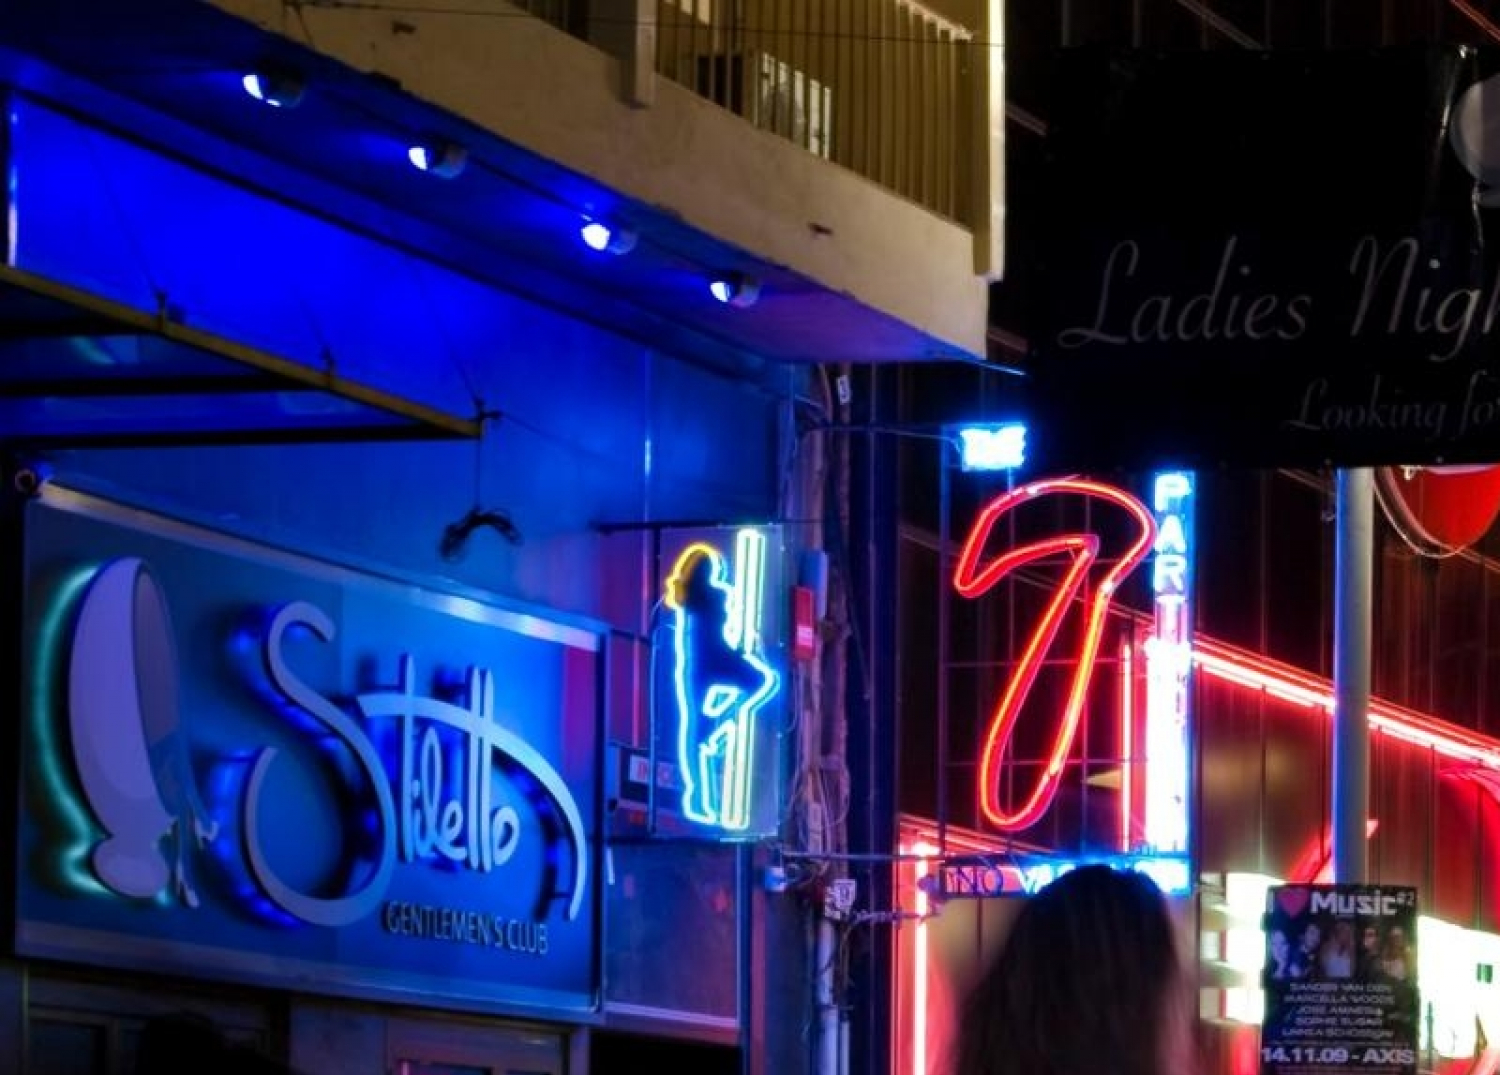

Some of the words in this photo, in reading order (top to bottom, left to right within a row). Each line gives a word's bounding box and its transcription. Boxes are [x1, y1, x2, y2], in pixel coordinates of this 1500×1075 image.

[1057, 233, 1312, 349] Ladies
[1279, 371, 1446, 441] Looking
[244, 600, 586, 927] Stiletto
[386, 901, 504, 948] GENTLEMEN'S
[508, 919, 548, 955] CLUB
[1310, 889, 1397, 916] Music
[1261, 1047, 1348, 1064] 14.11.09
[1362, 1048, 1415, 1064] AXIS
